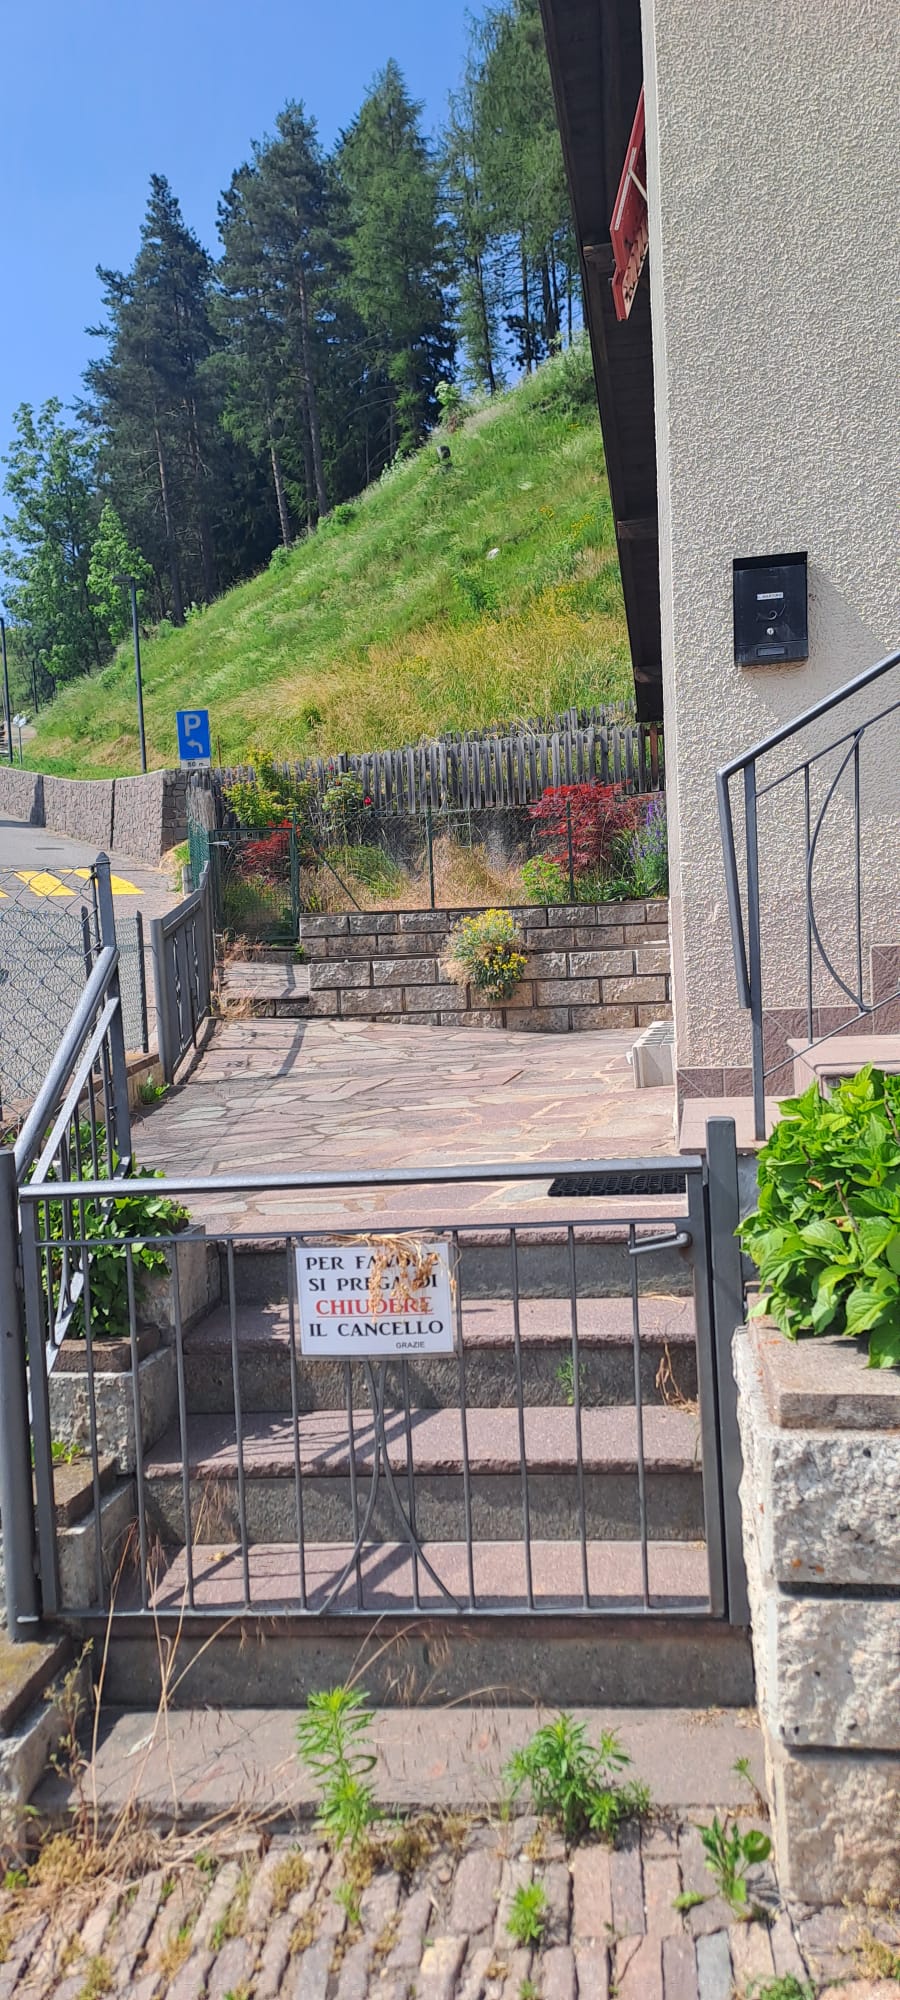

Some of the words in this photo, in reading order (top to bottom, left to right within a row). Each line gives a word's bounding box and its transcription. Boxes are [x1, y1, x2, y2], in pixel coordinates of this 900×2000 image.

[184, 714, 201, 737] P
[306, 1256, 345, 1270] PER
[309, 1278, 326, 1292] SI
[315, 1296, 434, 1315] CHIUDERE
[309, 1323, 328, 1337] IL
[337, 1320, 444, 1337] CANCELLO
[395, 1341, 425, 1349] GRAZIE
